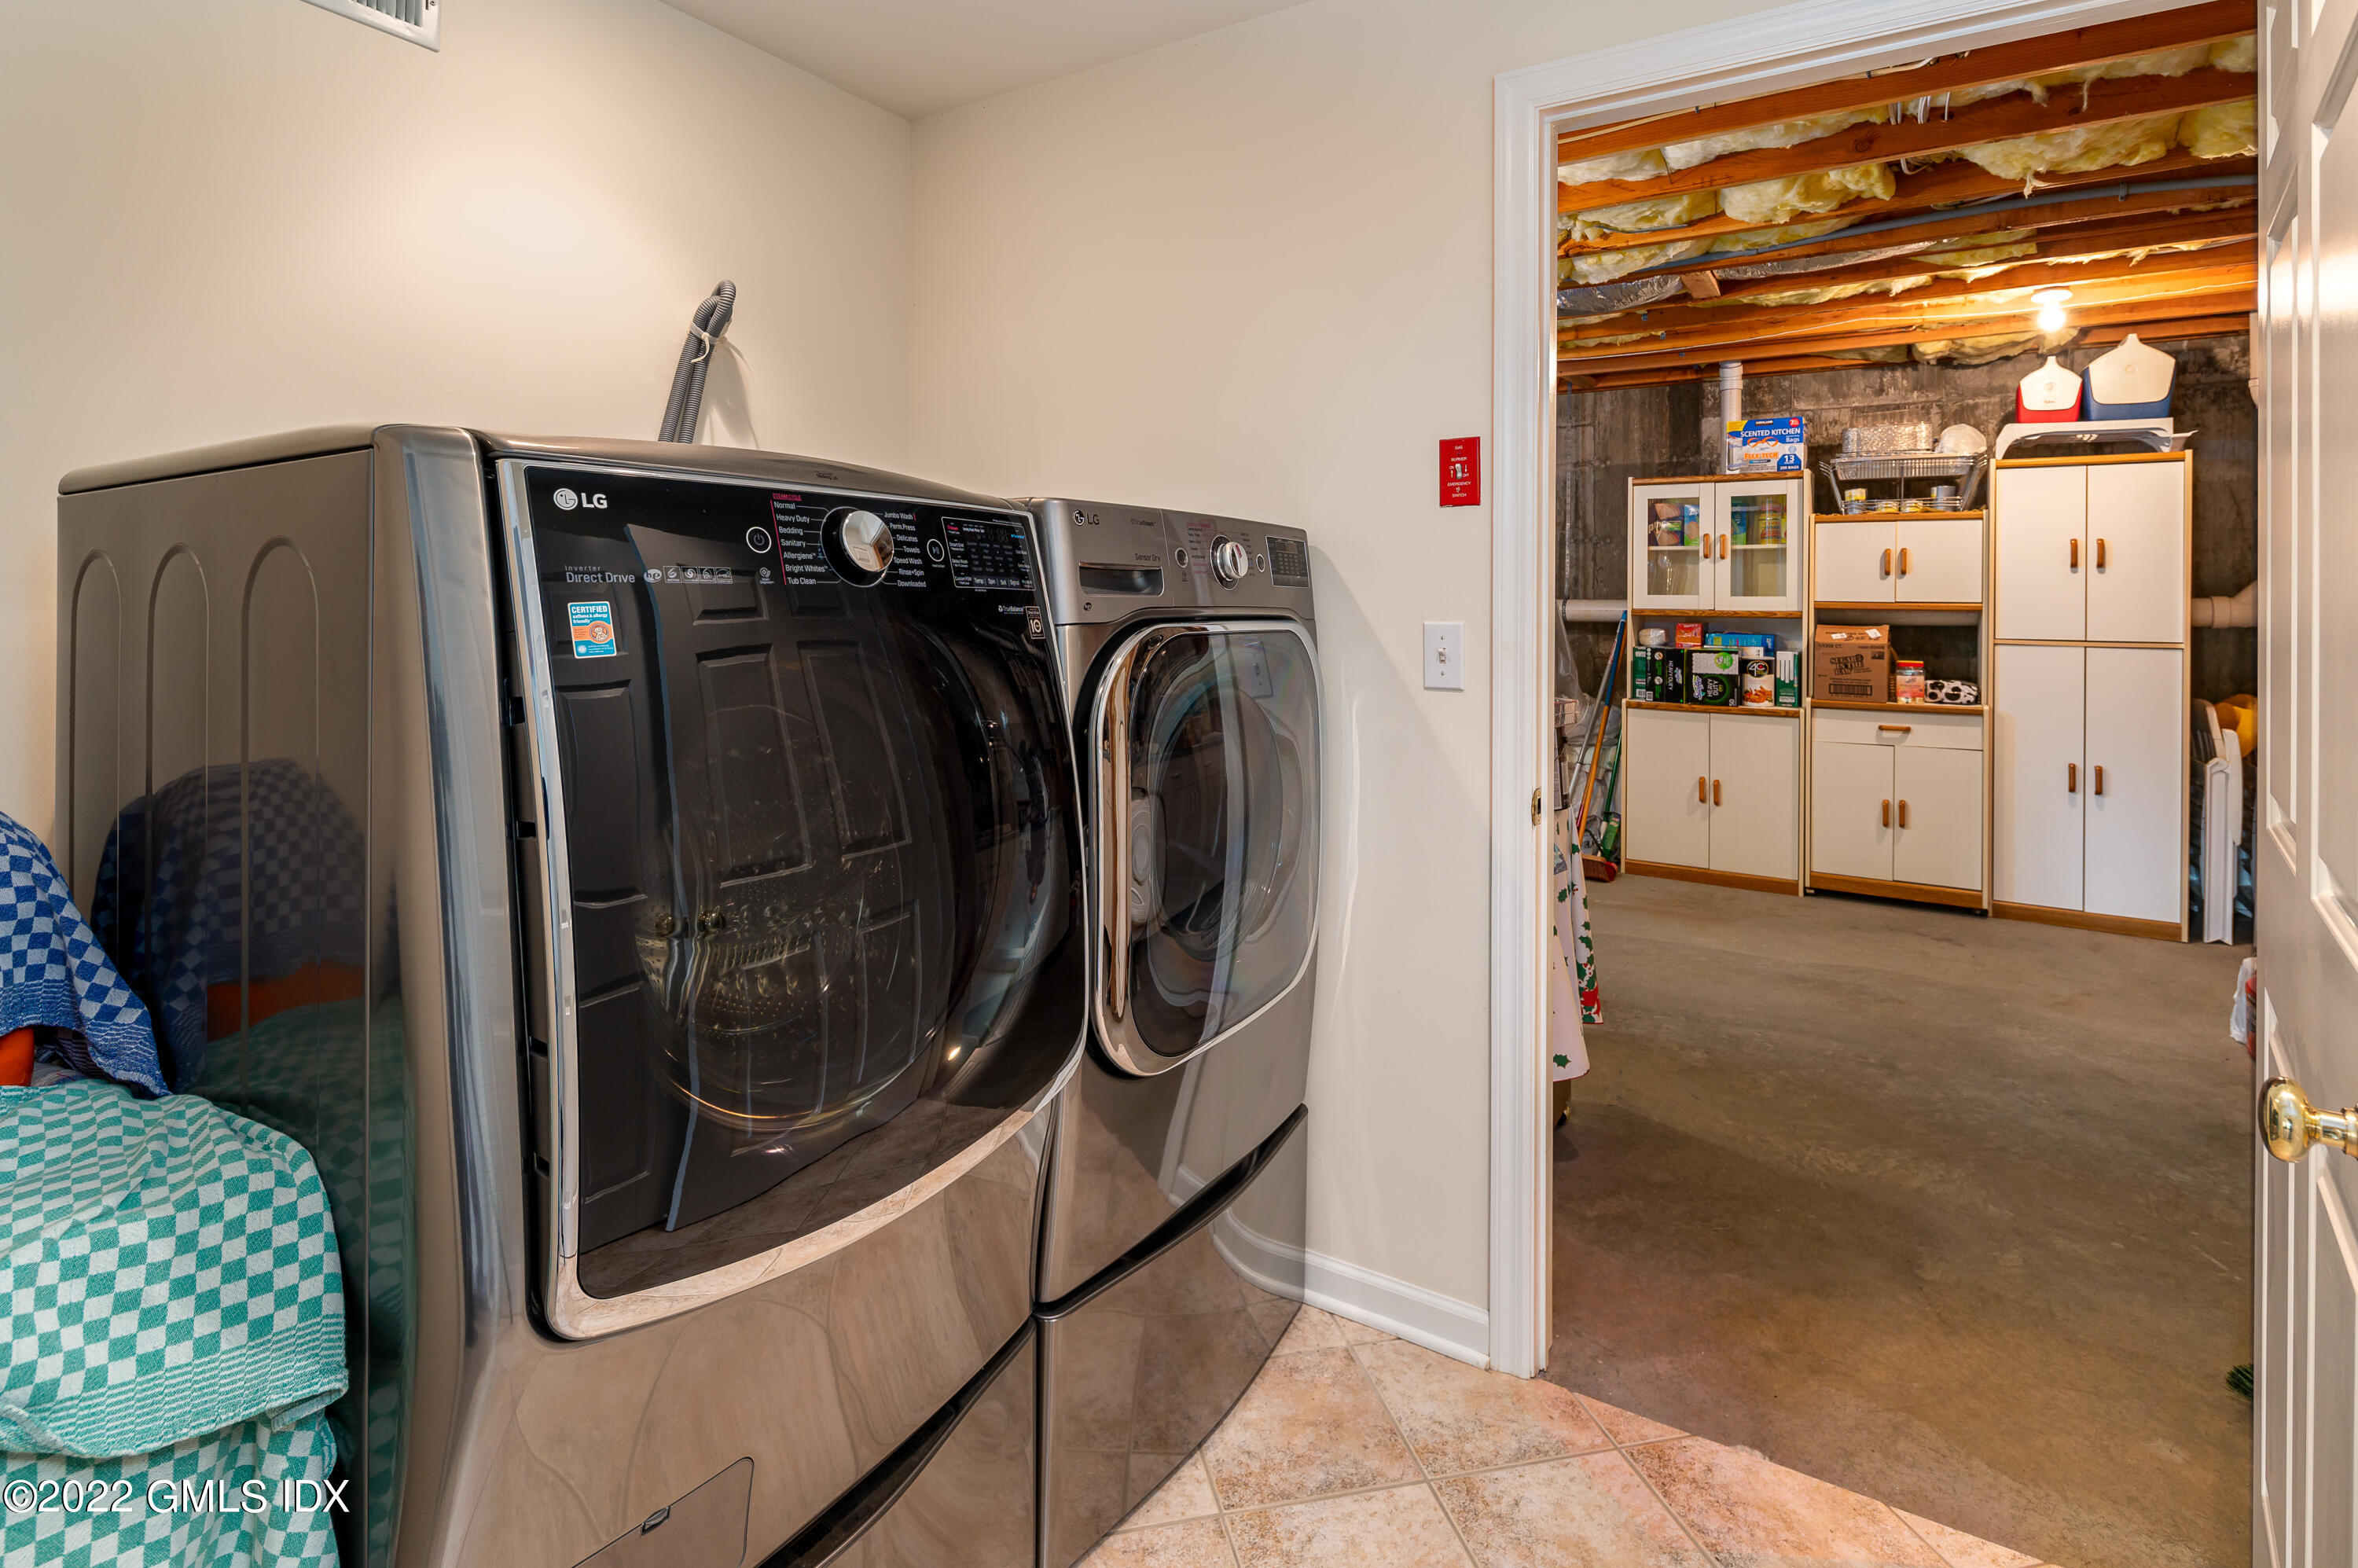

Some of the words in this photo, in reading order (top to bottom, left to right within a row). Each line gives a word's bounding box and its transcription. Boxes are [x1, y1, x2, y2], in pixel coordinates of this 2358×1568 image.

[581, 492, 608, 509] LG
[774, 501, 796, 510] Normal
[777, 514, 795, 523] Heavy
[796, 516, 810, 524] Duty
[1086, 513, 1100, 525] LG
[778, 527, 803, 536] Bedding
[780, 539, 806, 549] Sanitary
[1135, 553, 1151, 562] Sensor
[1152, 554, 1161, 563] Dry
[785, 564, 804, 574] Bright
[566, 572, 604, 583] Direct
[605, 573, 636, 583] Drive
[571, 605, 608, 614] CERTIFIED
[1030, 619, 1041, 633] 10
[1749, 663, 1765, 677] 4C
